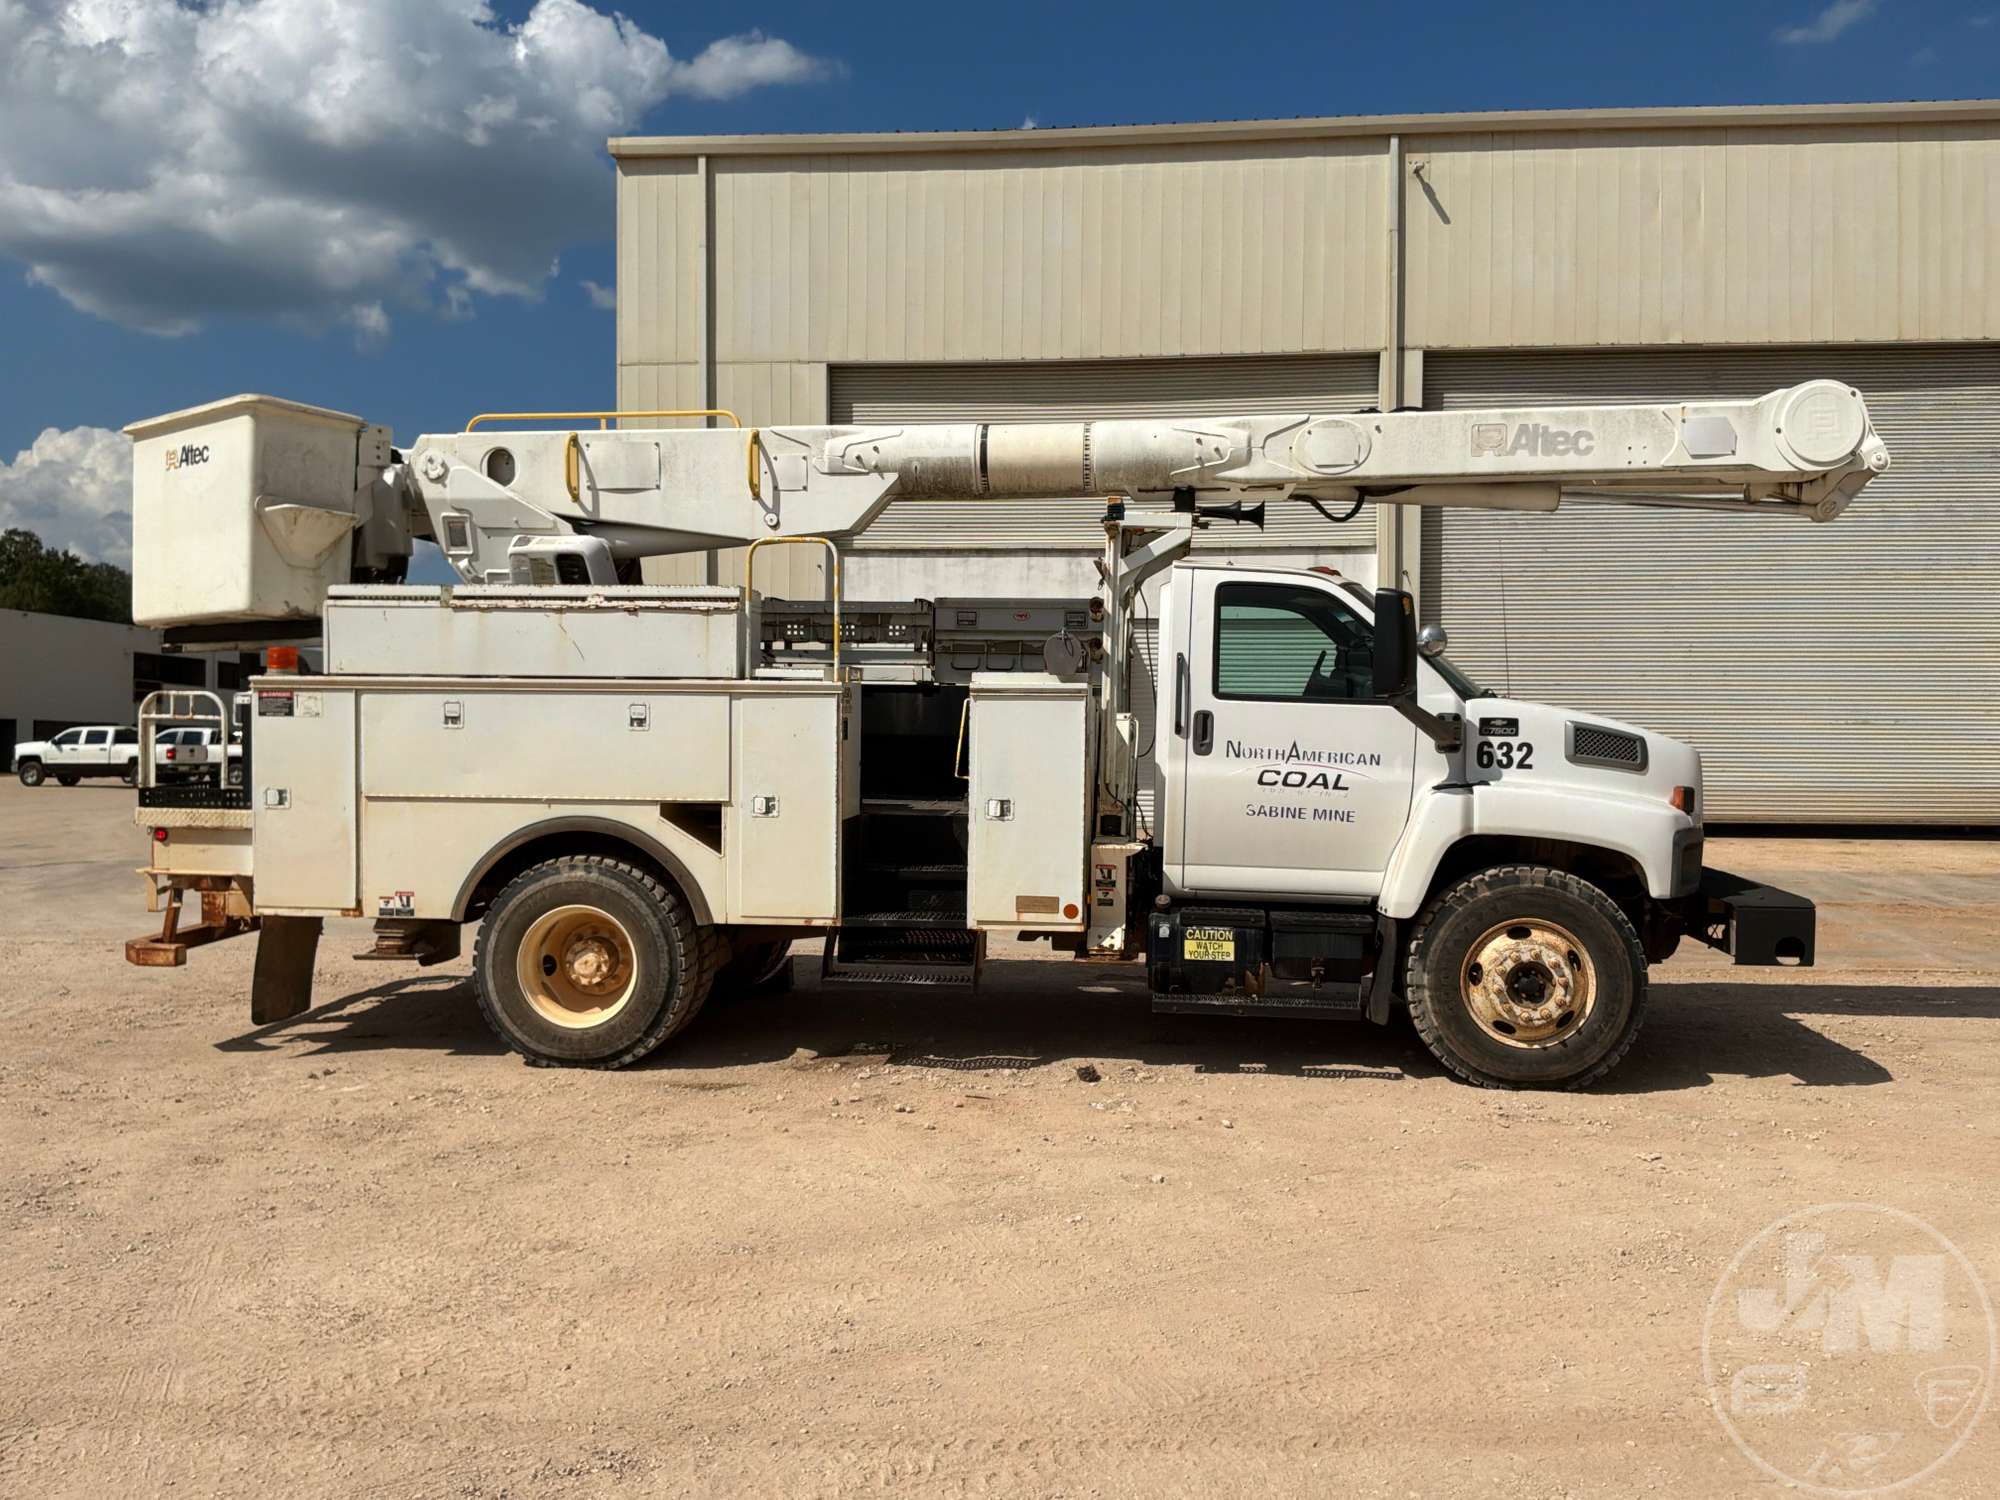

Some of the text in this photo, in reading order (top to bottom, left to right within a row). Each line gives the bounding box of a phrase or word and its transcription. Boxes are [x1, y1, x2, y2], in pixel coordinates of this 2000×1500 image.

[1509, 423, 1595, 457] Altec
[179, 444, 210, 468] Altec
[1476, 740, 1534, 770] 632
[1257, 769, 1351, 791] COAL
[1246, 804, 1356, 824] SABINE MINE
[1186, 929, 1233, 941] CAUTION
[1188, 950, 1210, 960] YOUR
[1196, 942, 1224, 950] WATCH
